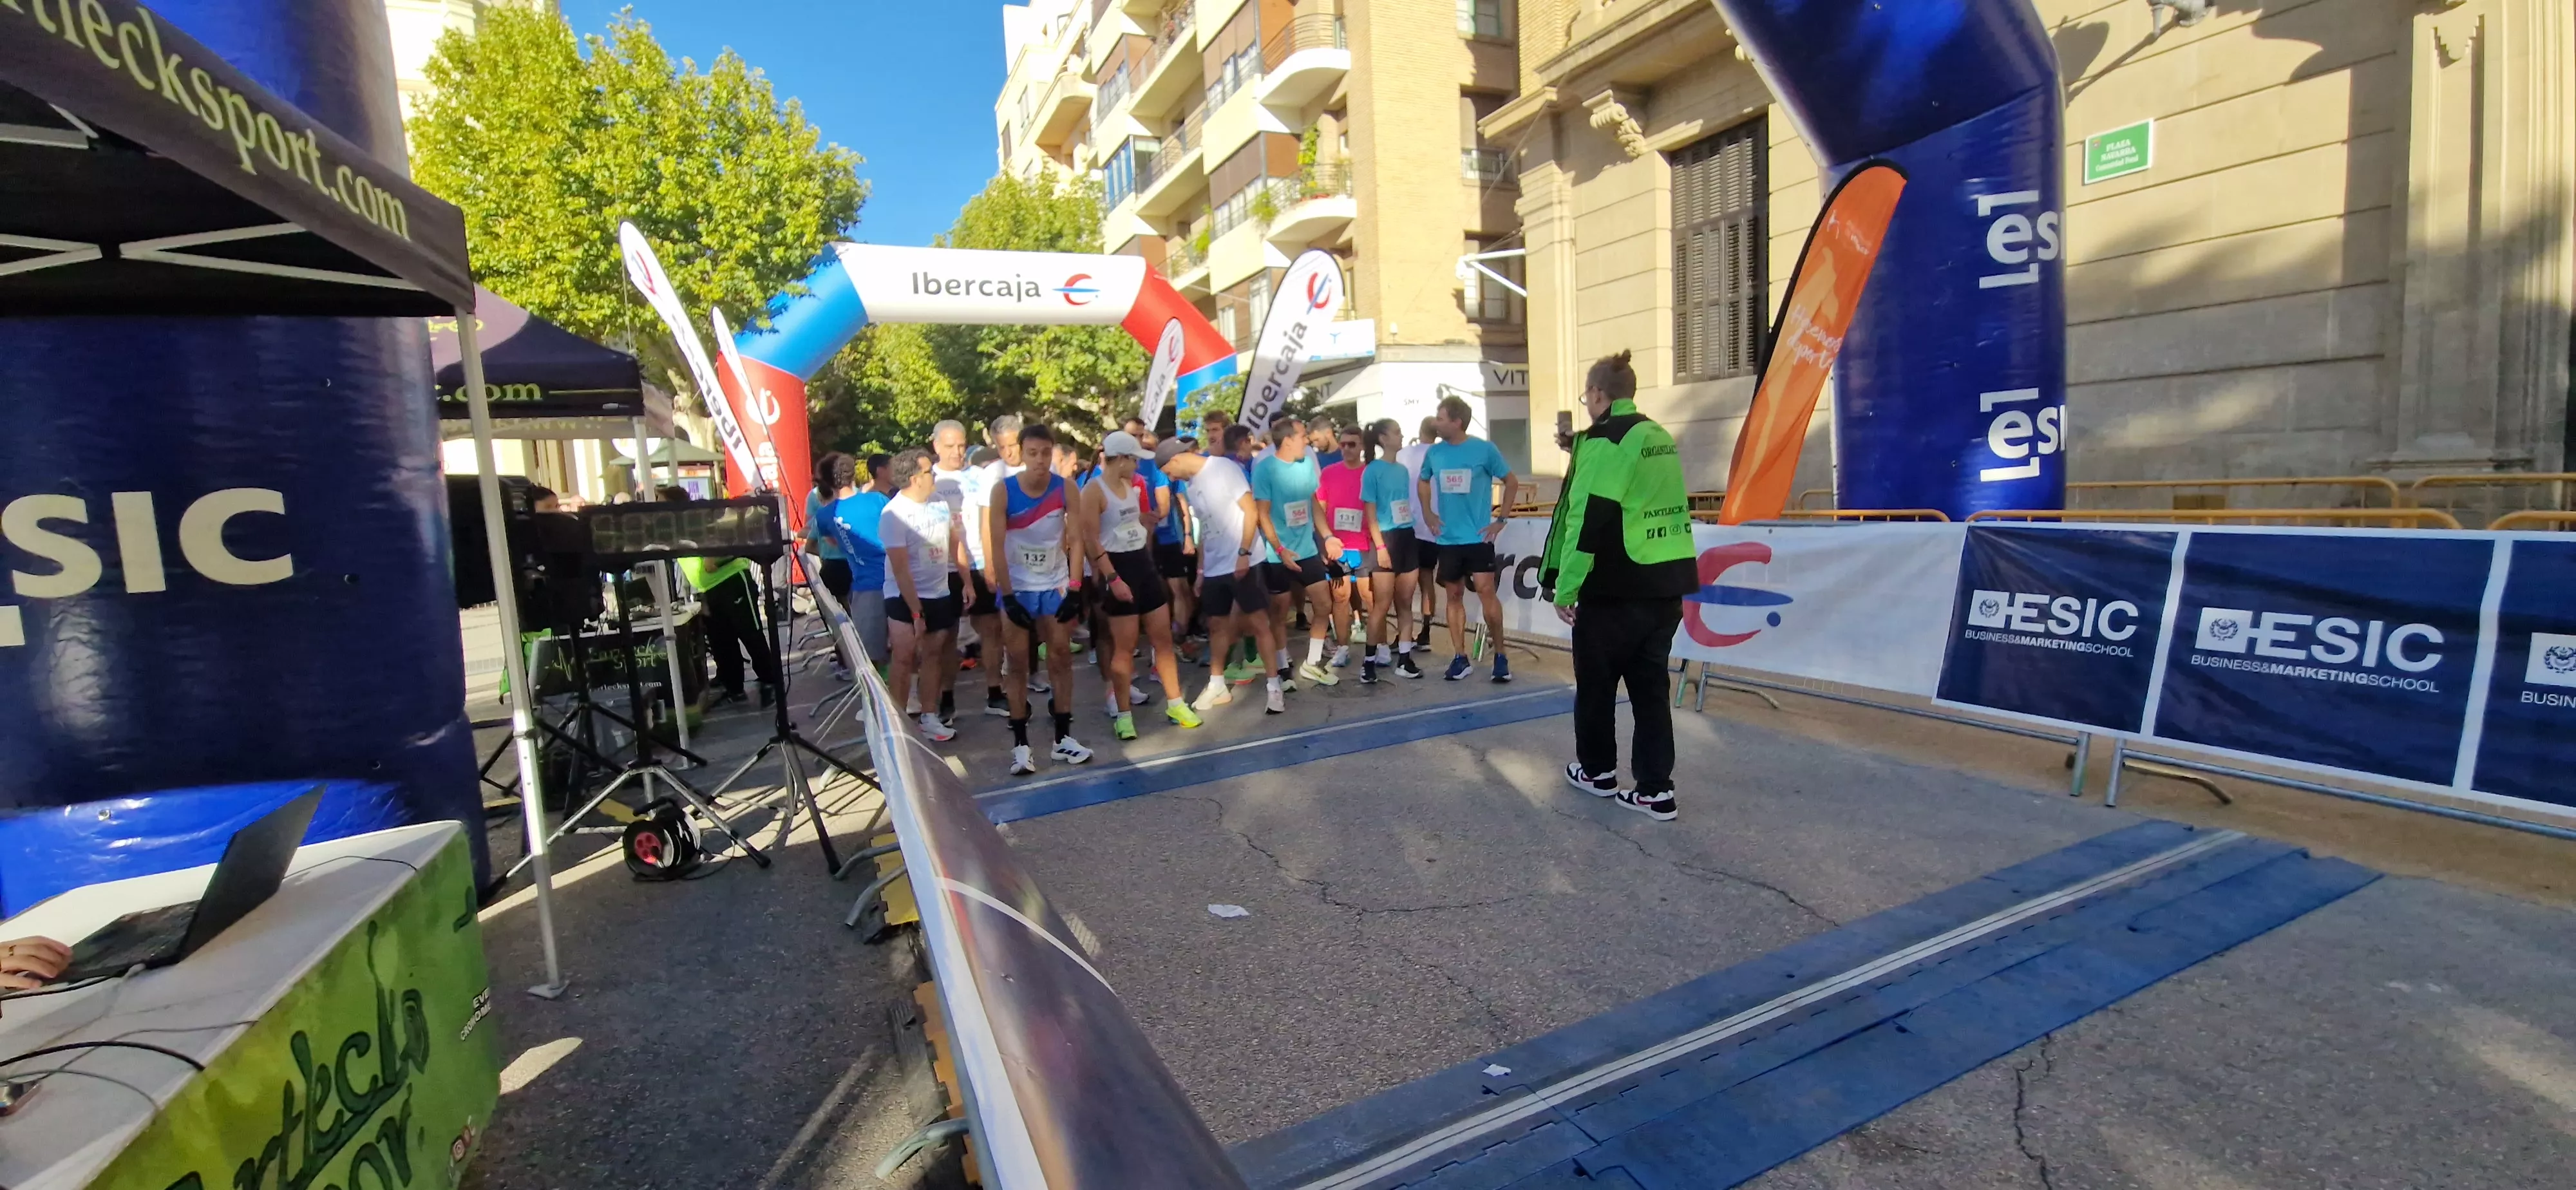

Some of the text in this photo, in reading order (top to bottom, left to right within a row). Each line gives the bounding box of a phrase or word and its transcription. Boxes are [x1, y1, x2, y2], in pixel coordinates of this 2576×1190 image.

[913, 271, 1042, 303] Ibercaja
[1246, 321, 1307, 430] Ibercaja
[435, 382, 544, 403] .com
[1340, 513, 1355, 522] 131
[1, 487, 294, 599] SIC
[1128, 529, 1139, 539] 50
[1023, 552, 1046, 563] 132
[2009, 592, 2139, 641] ESIC
[1964, 628, 2134, 658] BUSINESS&MARKETINGSCHOOL
[2254, 611, 2445, 672] ESIC
[2190, 654, 2440, 694] BUSINESS&MARKETINGSCHOOL
[2521, 690, 2576, 709] BUSIN
